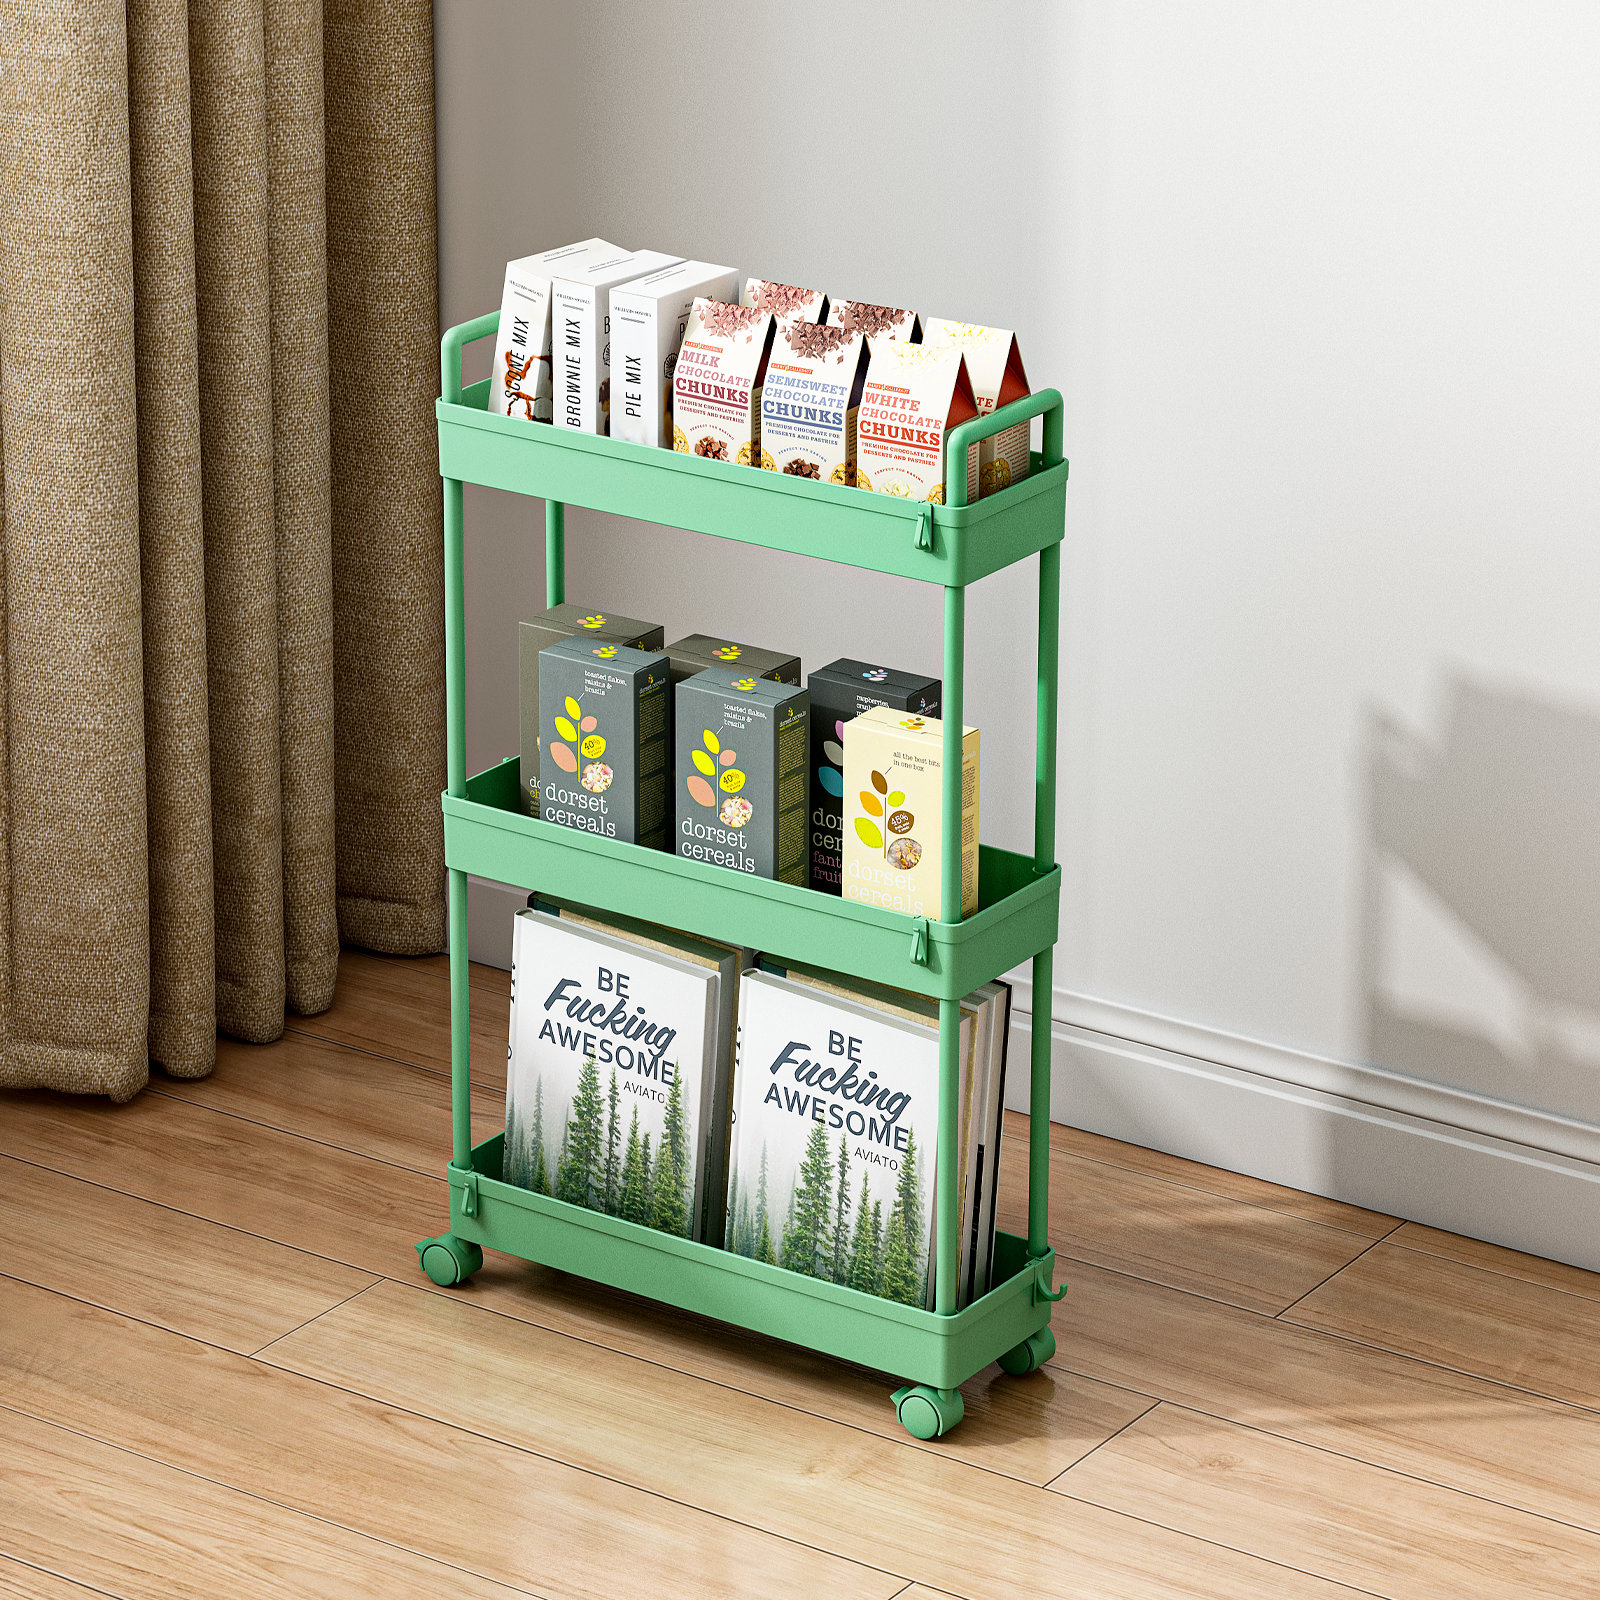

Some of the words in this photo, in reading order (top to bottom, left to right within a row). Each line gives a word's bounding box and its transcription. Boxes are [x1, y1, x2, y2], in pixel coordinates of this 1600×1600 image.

[512, 316, 529, 347] MIX
[566, 318, 581, 347] MIX
[625, 355, 642, 386] MIX
[681, 350, 720, 368] MILK
[677, 364, 751, 388] CHOCOLATE
[767, 374, 848, 396] SEMISWEET
[566, 356, 581, 427] BROWNIE
[675, 377, 749, 404] CHUNKS
[764, 387, 845, 409] CHOCOLATE
[864, 391, 921, 412] WHITE
[625, 392, 641, 417] PIE
[677, 398, 703, 408] PREMIUM
[703, 402, 735, 415] CHOCOLATE
[735, 410, 747, 418] FOR
[679, 405, 706, 416] DESSERTS
[719, 414, 745, 424] PASTRIES
[763, 400, 843, 426] CHUNKS
[765, 421, 793, 431] PREMIUM
[793, 426, 828, 437] CHOCOLATE
[861, 406, 942, 430] CHOCOLATE
[767, 428, 796, 438] DESSERTS
[810, 436, 838, 446] PASTRIES
[859, 420, 940, 446] CHUNKS
[861, 441, 889, 451] PREMIUM
[889, 446, 925, 458] CHOCOLATE
[863, 448, 893, 458] DESSERTS
[907, 457, 936, 467] PASTRIES
[902, 752, 913, 761] the
[545, 782, 609, 815] dorset
[545, 807, 616, 837] cereals
[812, 807, 843, 831] dor
[891, 812, 909, 826] 45%
[681, 816, 748, 850] dorset
[681, 841, 756, 873] cereals
[848, 859, 916, 893] dorset
[848, 884, 924, 916] cereals
[597, 966, 630, 999] BE
[543, 977, 677, 1059] Fucking
[538, 1018, 675, 1087] AWESOME
[828, 1029, 863, 1064] BE
[623, 1080, 666, 1104] AVIATO
[769, 1040, 912, 1125] Fucking
[764, 1082, 910, 1153] AWESOME
[854, 1146, 899, 1171] AVIATO
